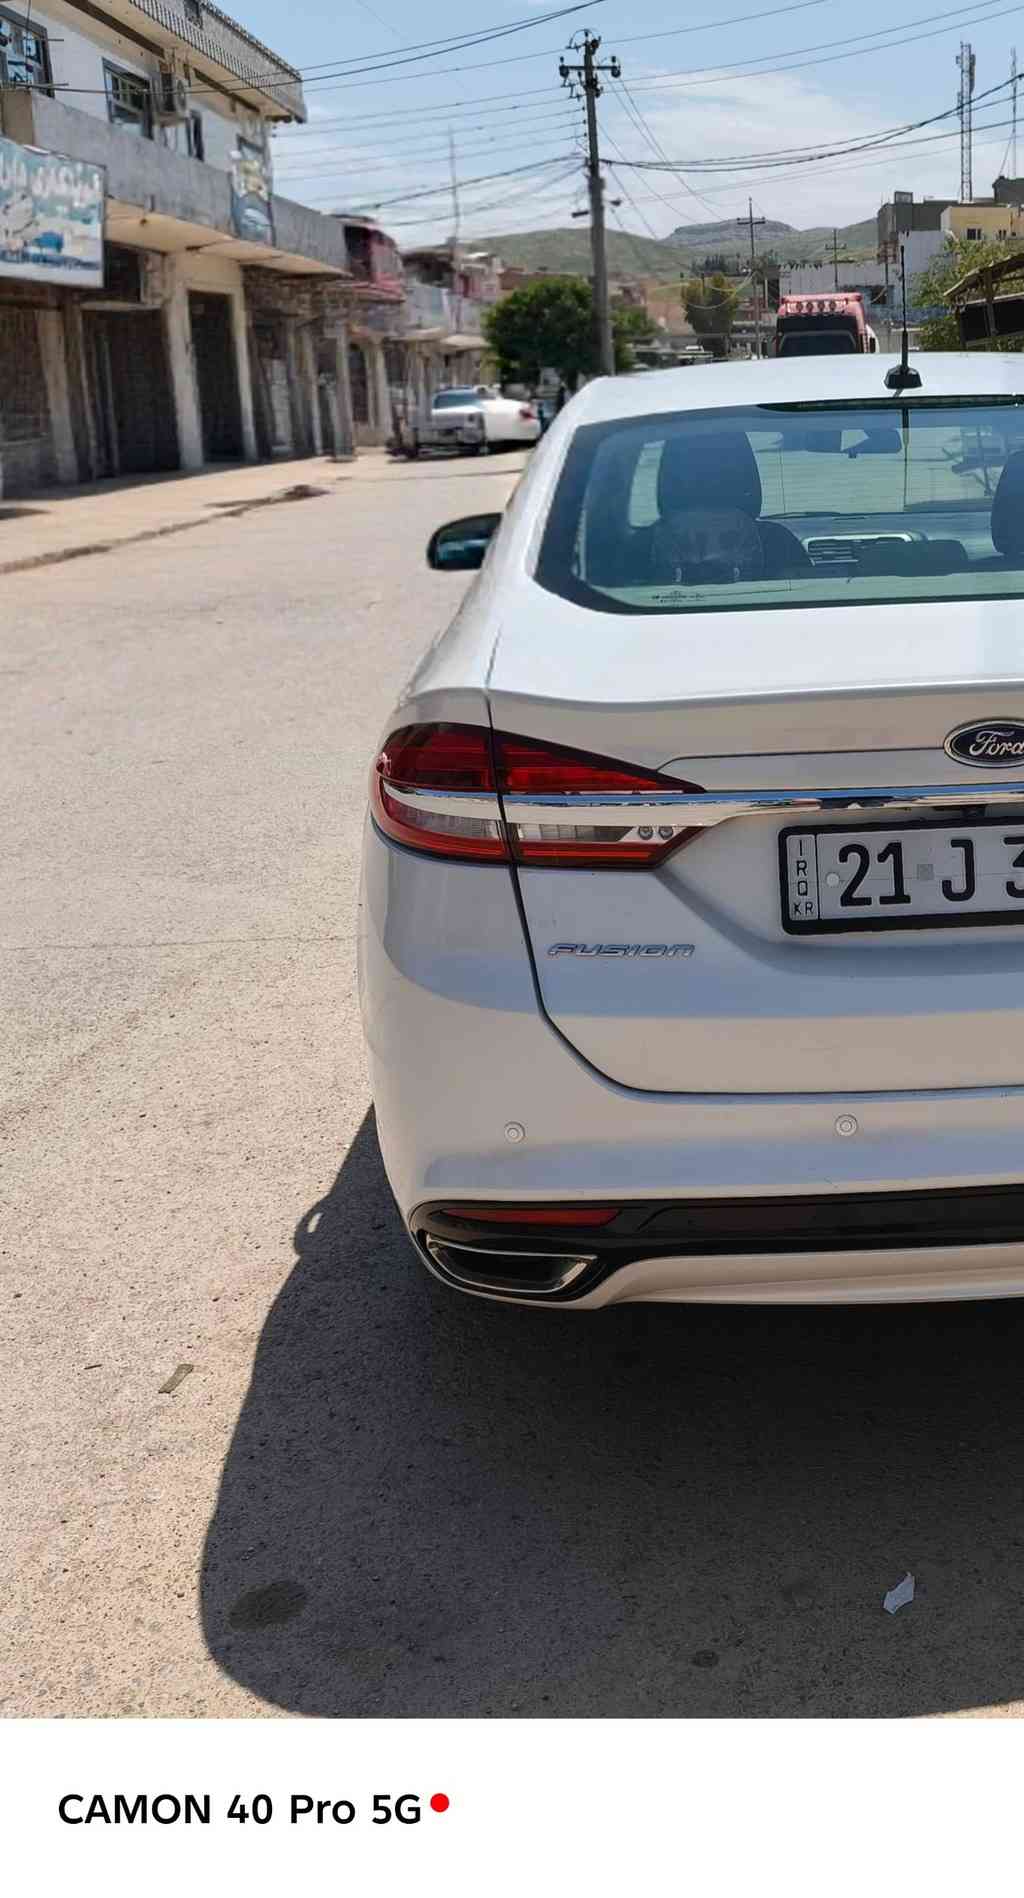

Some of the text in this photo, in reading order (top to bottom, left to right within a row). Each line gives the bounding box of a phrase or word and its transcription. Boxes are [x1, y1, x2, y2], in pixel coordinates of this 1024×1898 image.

[838, 842, 911, 907] 21
[942, 839, 975, 901] J
[794, 902, 814, 915] KR
[547, 943, 696, 957] FUSION
